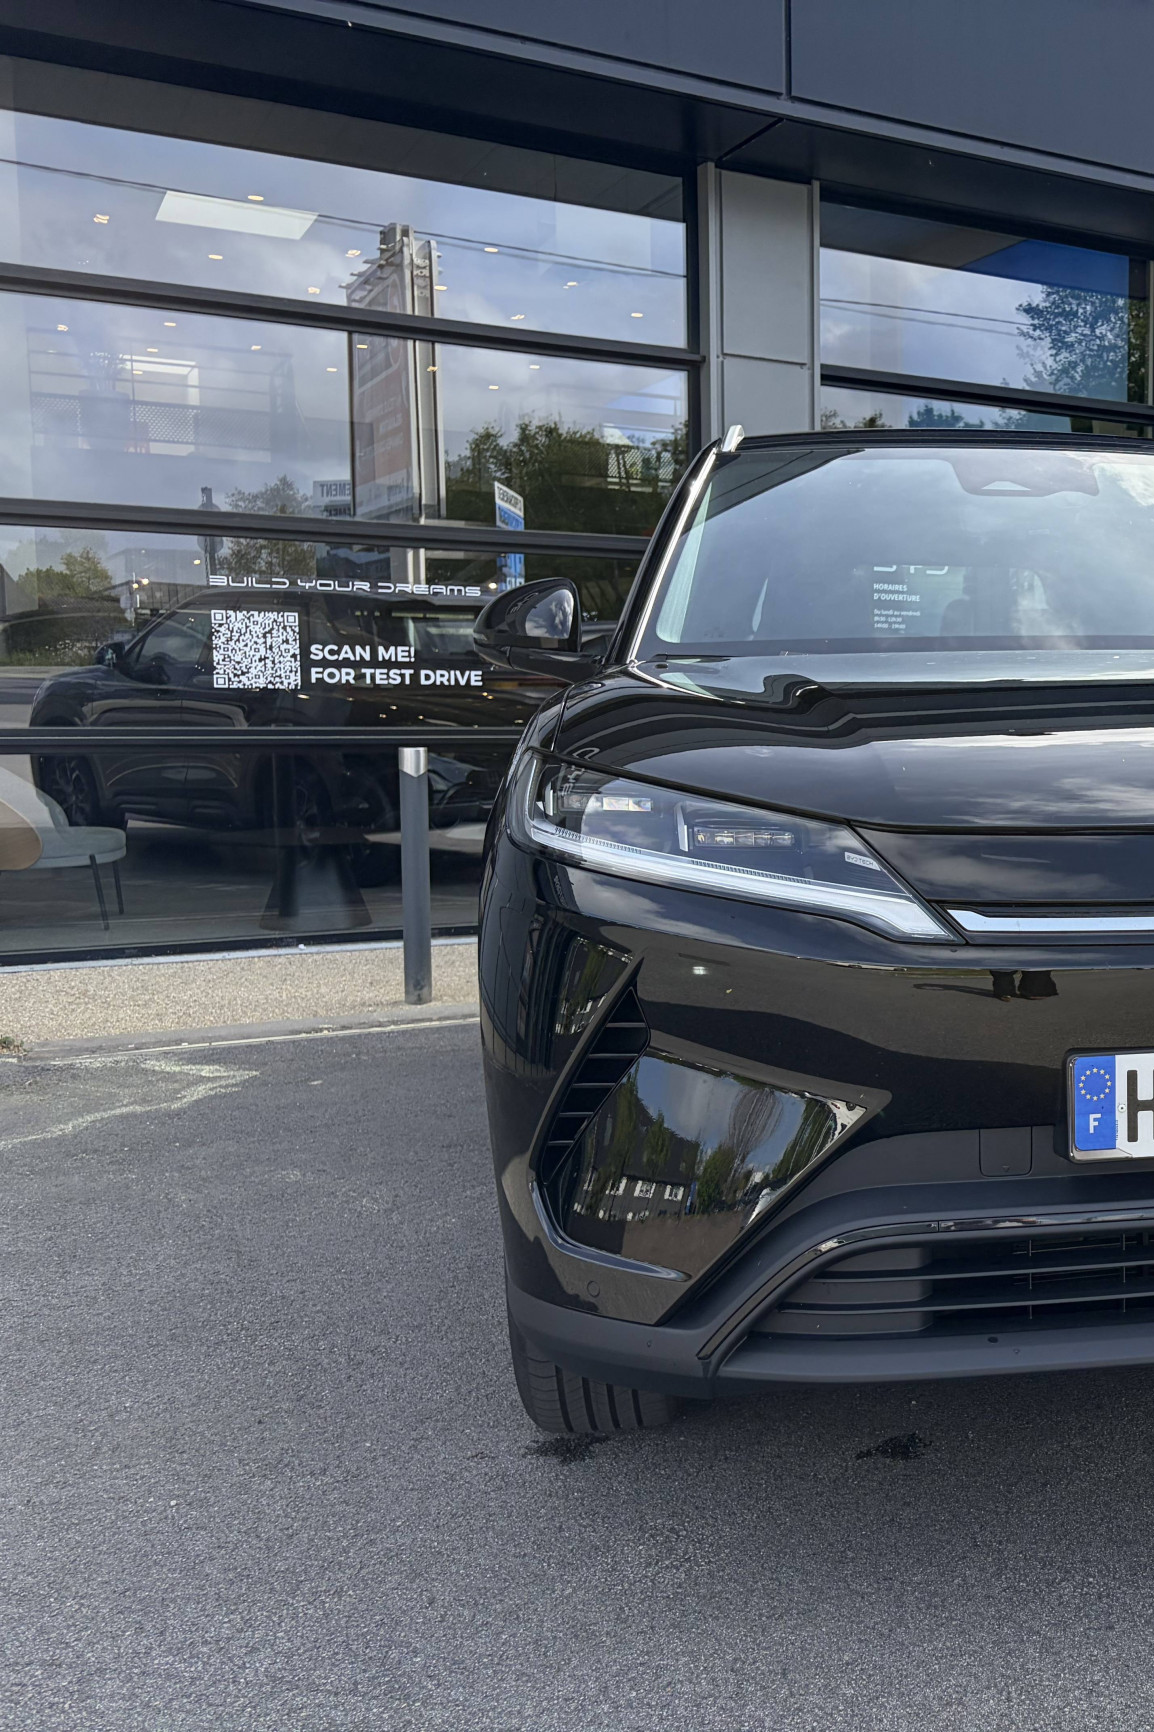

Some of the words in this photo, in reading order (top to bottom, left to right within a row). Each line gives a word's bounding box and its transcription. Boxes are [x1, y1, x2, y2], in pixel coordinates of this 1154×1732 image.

[208, 575, 290, 589] BUILD
[297, 580, 371, 593] YOUR
[377, 582, 482, 597] DREAMS
[873, 583, 908, 591] HORAIRES
[873, 593, 920, 601] D'OUVERTURE
[309, 643, 371, 661] SCAN
[377, 645, 416, 663] ME!
[310, 667, 356, 684] FOR
[361, 668, 414, 685] TEST
[420, 669, 483, 687] DRIVE
[1088, 1113, 1102, 1134] F
